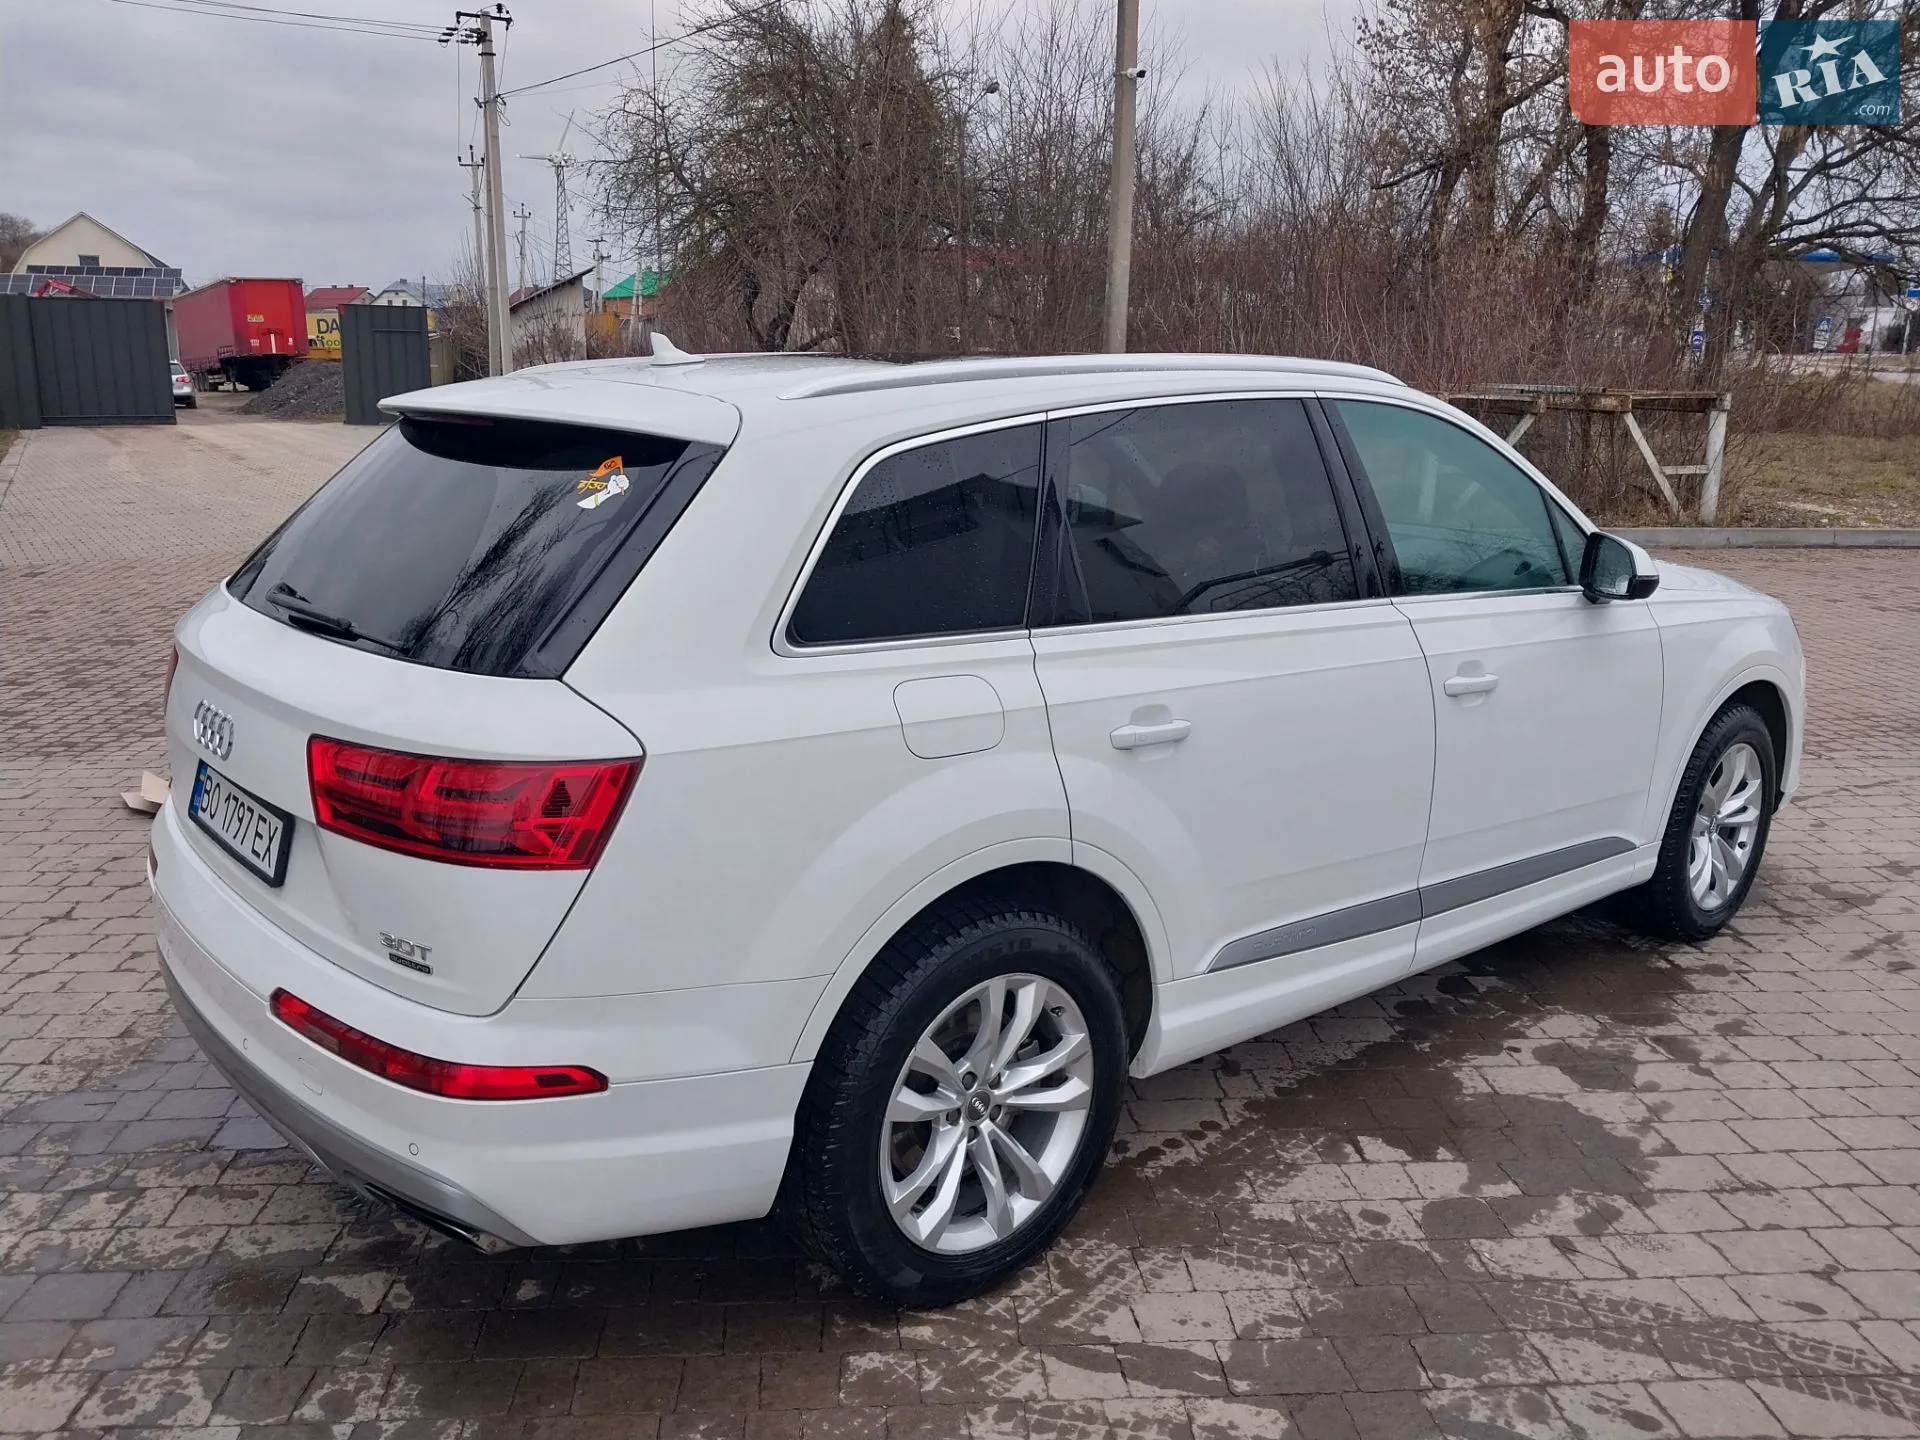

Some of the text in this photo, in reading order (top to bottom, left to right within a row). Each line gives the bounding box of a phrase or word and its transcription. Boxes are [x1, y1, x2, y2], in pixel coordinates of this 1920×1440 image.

[200, 774, 279, 868] BO 1797 EX
